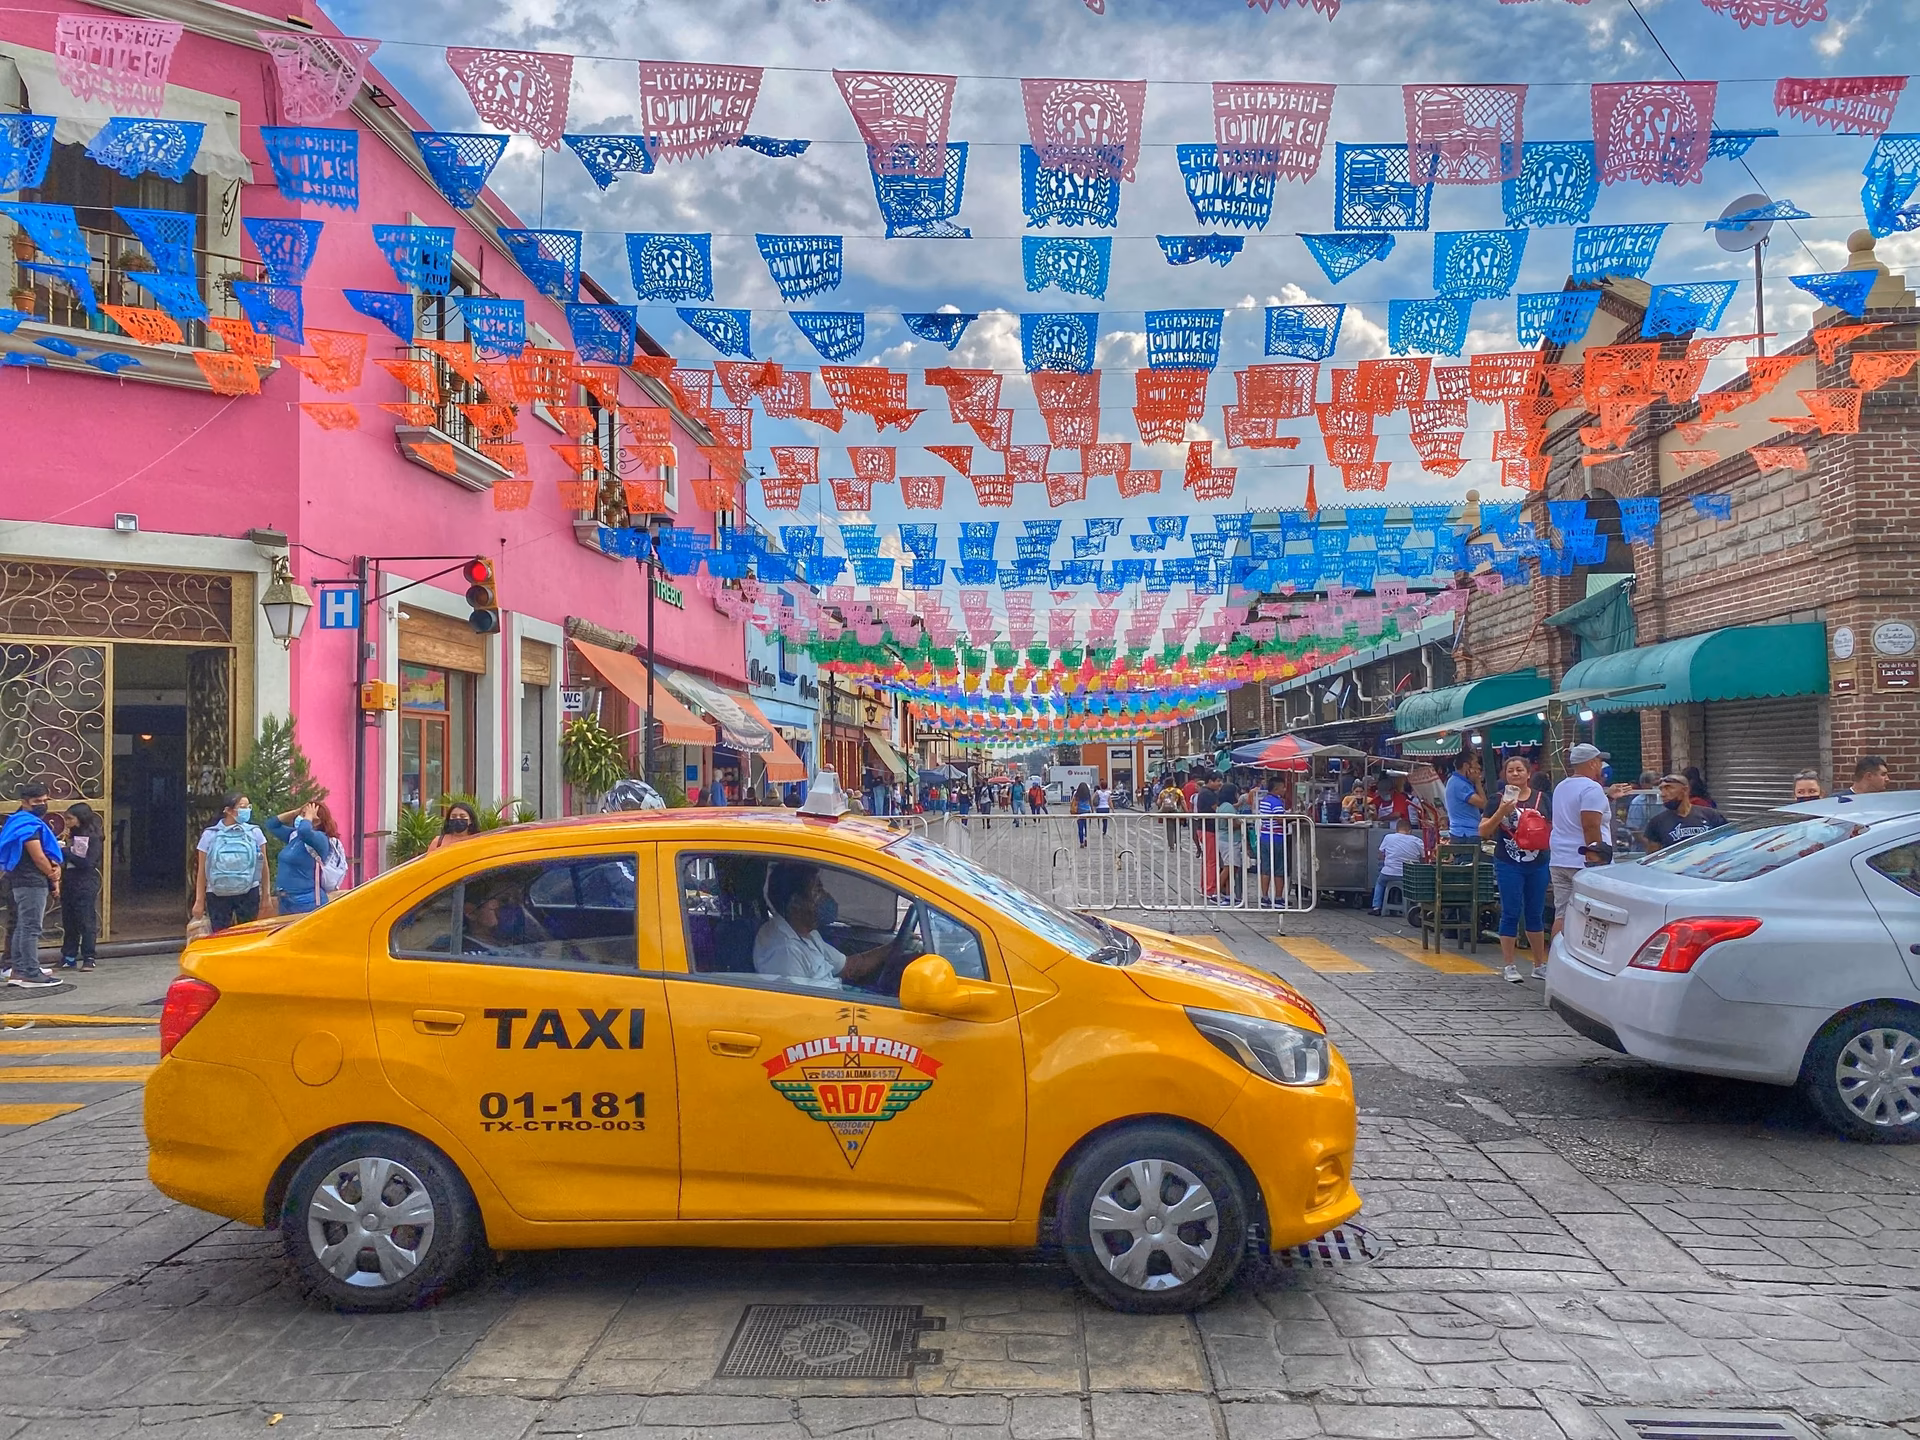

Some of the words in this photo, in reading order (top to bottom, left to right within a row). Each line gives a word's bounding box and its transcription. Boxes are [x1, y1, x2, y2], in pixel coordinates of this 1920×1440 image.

[326, 592, 352, 626] H
[484, 1008, 645, 1049] TAXI
[785, 1035, 918, 1064] MULTITAXI
[845, 1070, 872, 1078] ALDANA
[479, 1092, 645, 1118] 01-181
[818, 1084, 887, 1114] ADO
[480, 1120, 646, 1132] TX-CTRO-003
